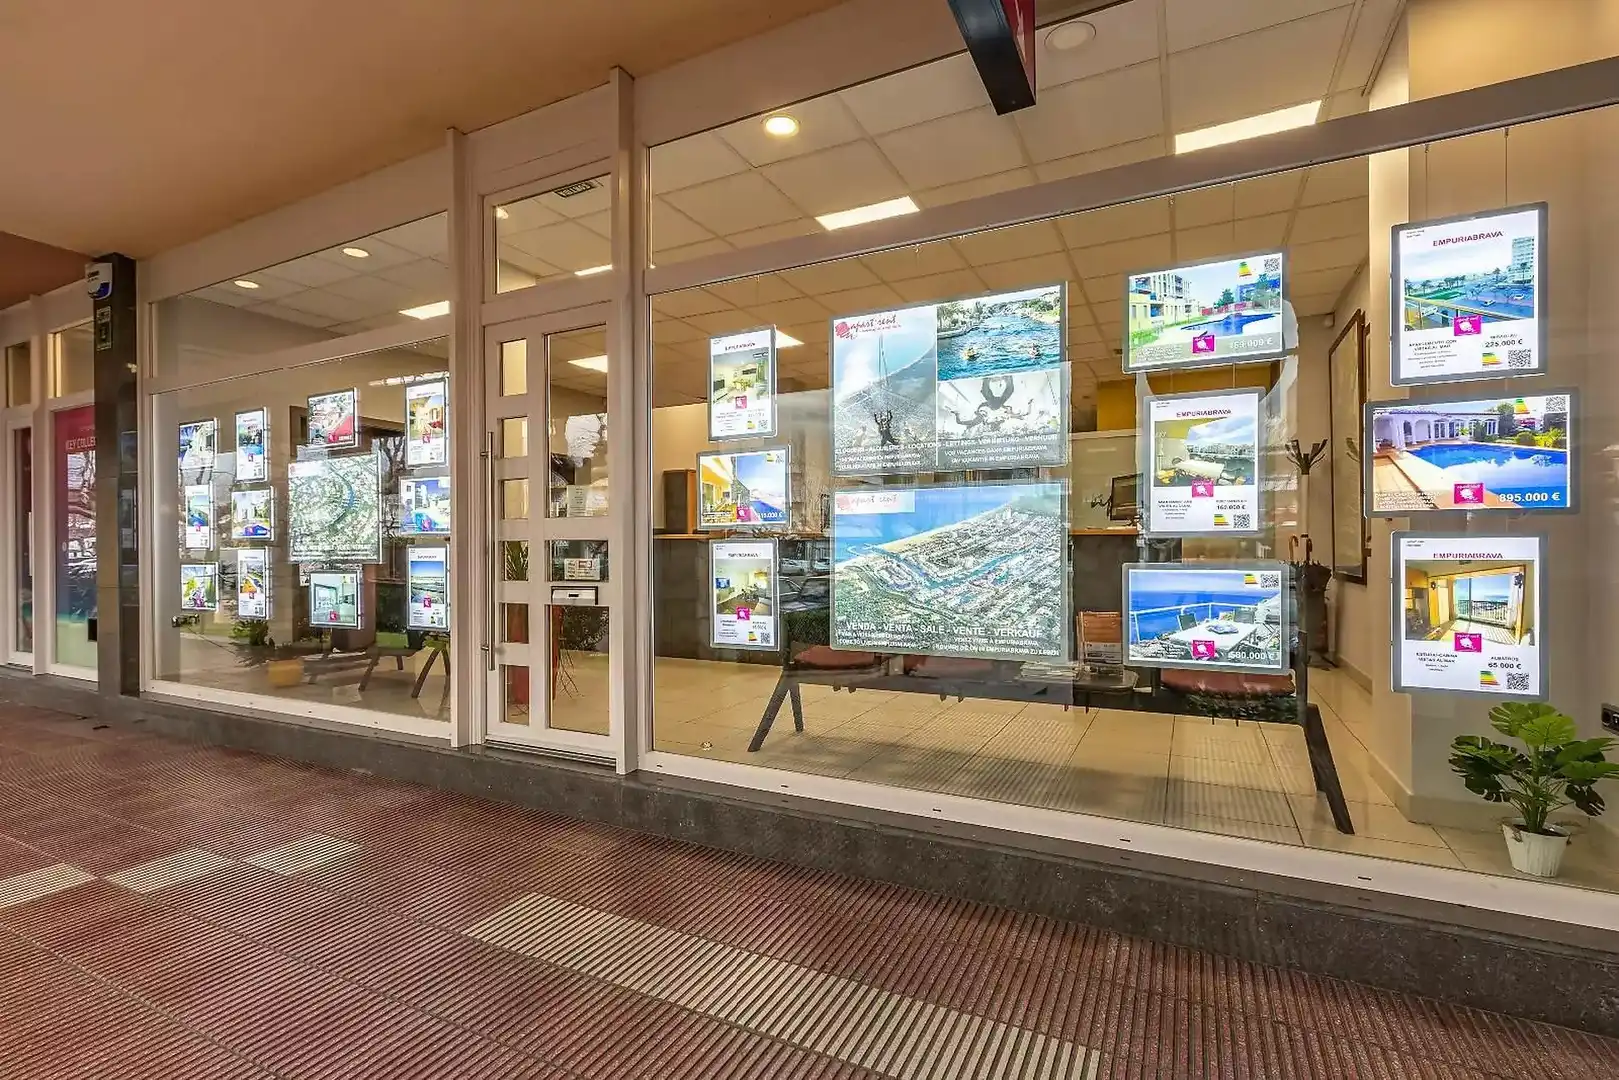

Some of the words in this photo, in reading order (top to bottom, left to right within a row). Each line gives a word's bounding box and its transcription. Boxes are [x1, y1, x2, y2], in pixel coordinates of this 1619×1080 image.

[1432, 230, 1504, 247] EMPURIABRAVA
[1499, 493, 1549, 503] 895.000
[1551, 492, 1561, 501] €
[846, 621, 877, 631] VENDA
[883, 623, 914, 633] VENTA
[920, 625, 945, 634] SALE
[953, 626, 986, 636] VENTE
[994, 627, 1043, 638] VERKAUF
